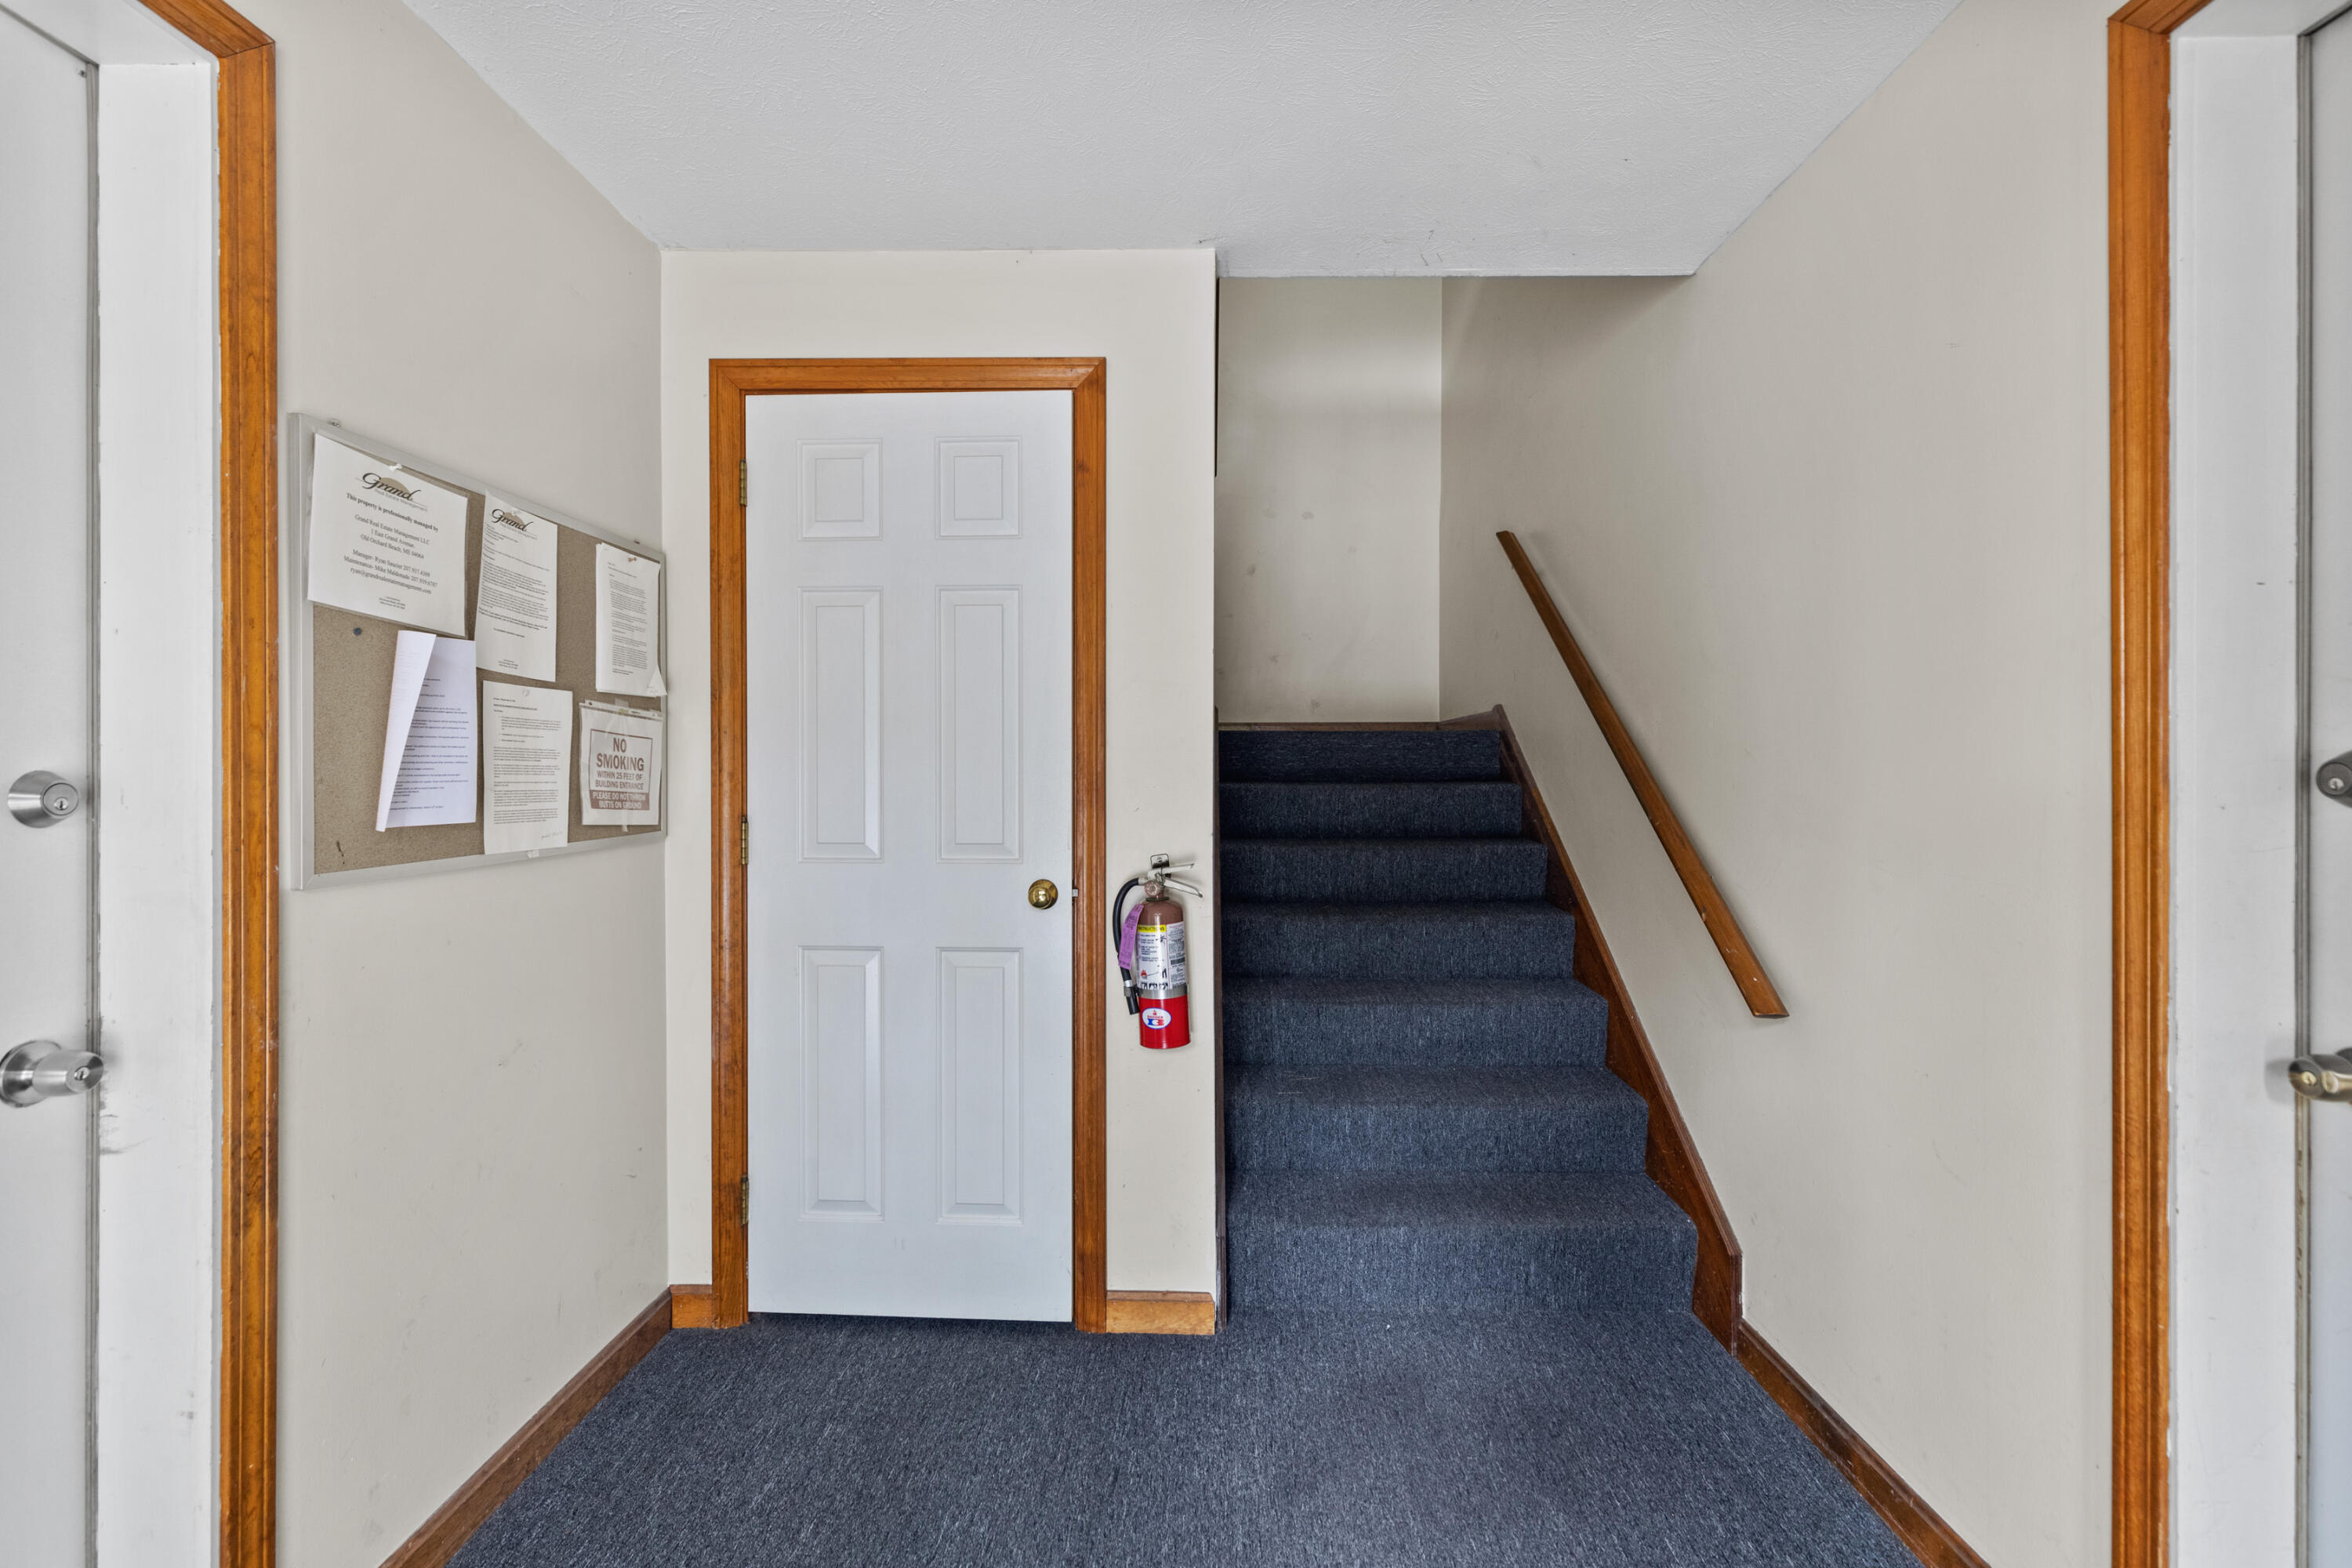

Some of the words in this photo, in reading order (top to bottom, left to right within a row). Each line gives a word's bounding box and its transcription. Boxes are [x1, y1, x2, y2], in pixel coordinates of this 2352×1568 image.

[362, 473, 422, 501] Grand
[347, 493, 357, 502] This
[358, 497, 377, 510] property
[383, 507, 412, 524] professionally
[413, 518, 433, 531] managed
[354, 514, 369, 524] Grand
[369, 518, 379, 528] Real
[380, 523, 393, 532] Estate
[394, 528, 420, 541] Management
[491, 509, 533, 532] Grand
[375, 529, 384, 539] East
[384, 533, 398, 543] Grand
[361, 533, 369, 543] Old
[370, 537, 387, 547] Orchard
[403, 547, 411, 556] ME
[375, 556, 387, 565] Ryan
[375, 564, 387, 573] Mike
[613, 737, 627, 753] NO
[596, 753, 644, 771] SMOKING
[595, 779, 619, 789] BUILDING
[619, 781, 644, 790] ENTRANCE
[592, 791, 612, 800] PLEASE
[612, 792, 620, 800] DO
[598, 800, 615, 808] BUTTS
